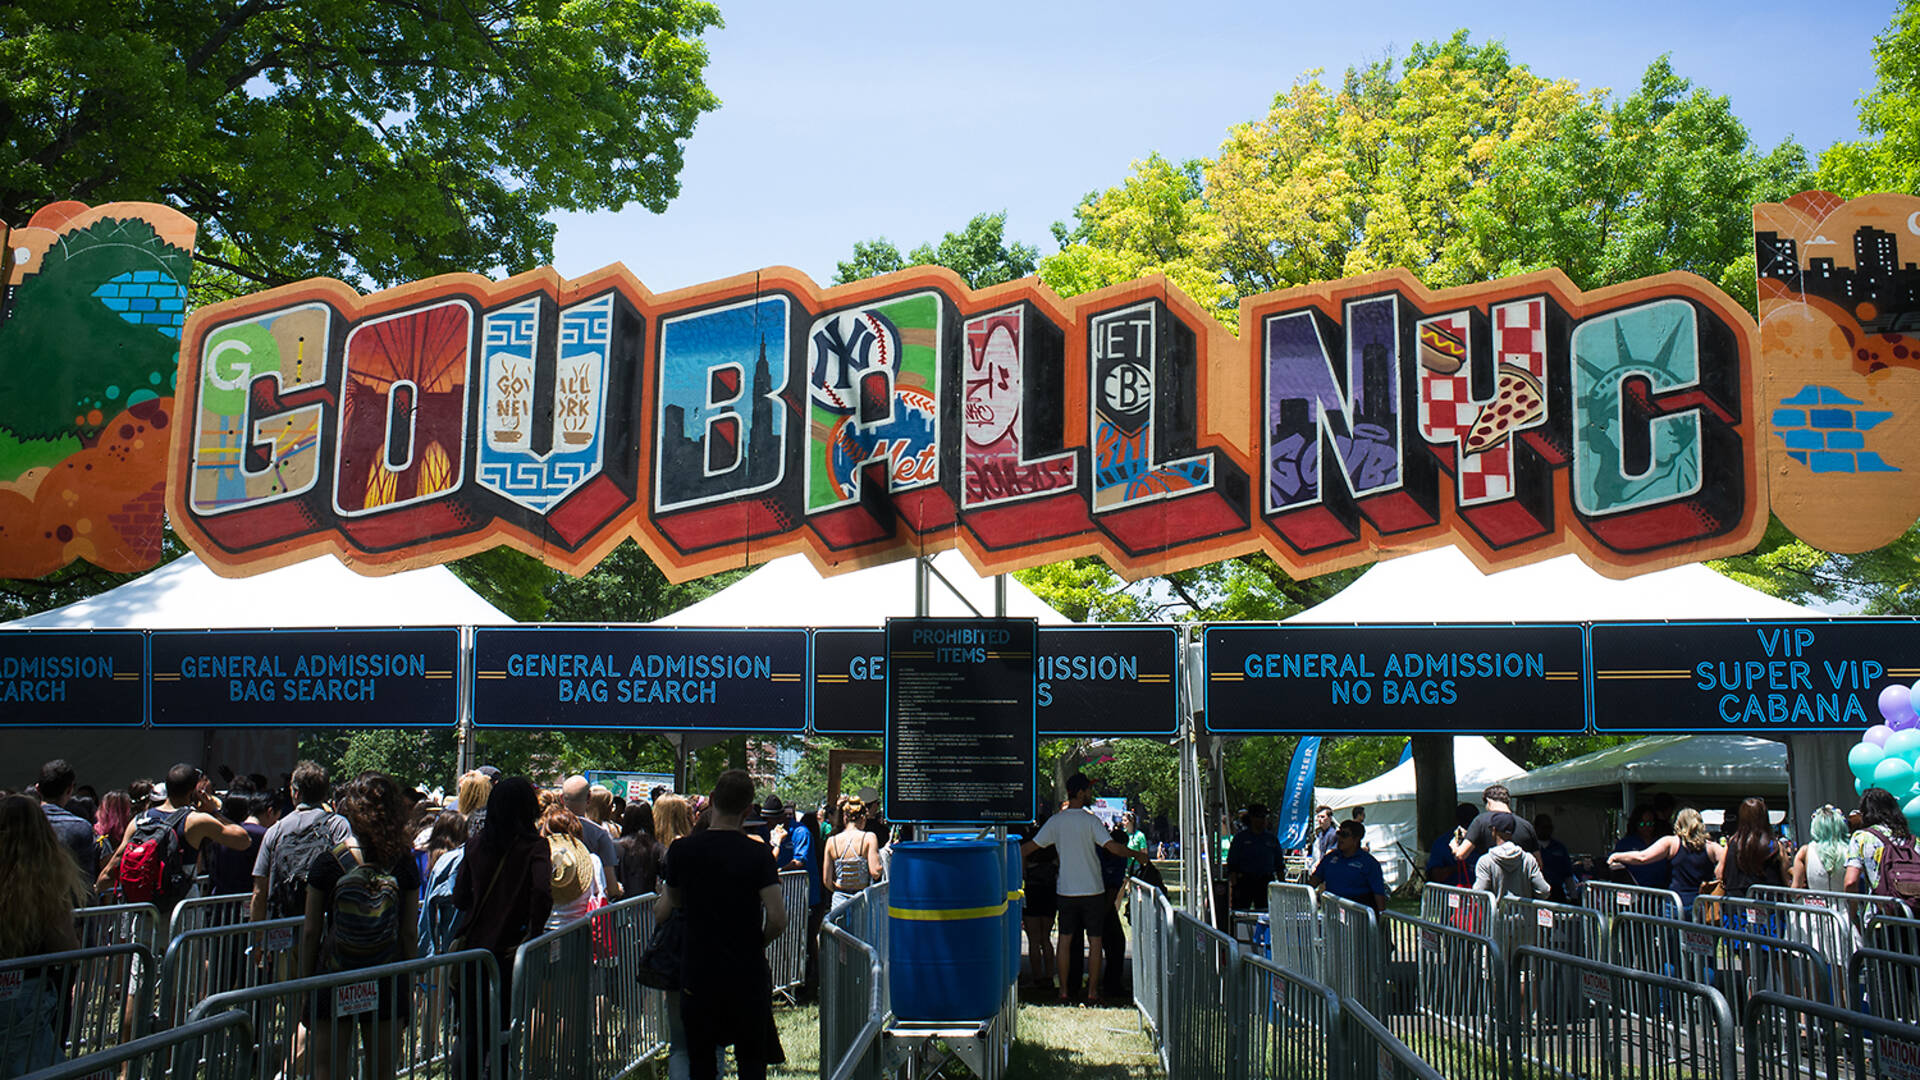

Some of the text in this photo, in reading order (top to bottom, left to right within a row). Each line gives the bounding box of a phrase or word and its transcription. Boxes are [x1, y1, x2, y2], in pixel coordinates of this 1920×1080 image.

[655, 291, 1215, 514] BALL
[1265, 294, 1702, 515] NYC
[913, 629, 1010, 644] PROHIBITED
[1757, 628, 1815, 657] VIP
[0, 656, 113, 678] DMISSION
[181, 655, 426, 678] GENERAL ADMISSION
[507, 654, 771, 679] GENERAL ADMISSION
[850, 655, 1137, 680] GE ISSION
[937, 647, 986, 663] ITEMS
[1244, 653, 1544, 678] GENERAL ADMISSION
[1696, 660, 1883, 690] SUPER VIP
[229, 680, 375, 701] BAG SEARCH
[559, 681, 716, 703] BAG SEARCH
[1038, 682, 1053, 707] S
[1331, 680, 1458, 705] NO BAGS
[1719, 693, 1868, 723] CABANA
[1291, 748, 1313, 821] SENNHEISER
[338, 979, 376, 1000] NATIONAL
[1880, 1036, 1920, 1068] NATION
